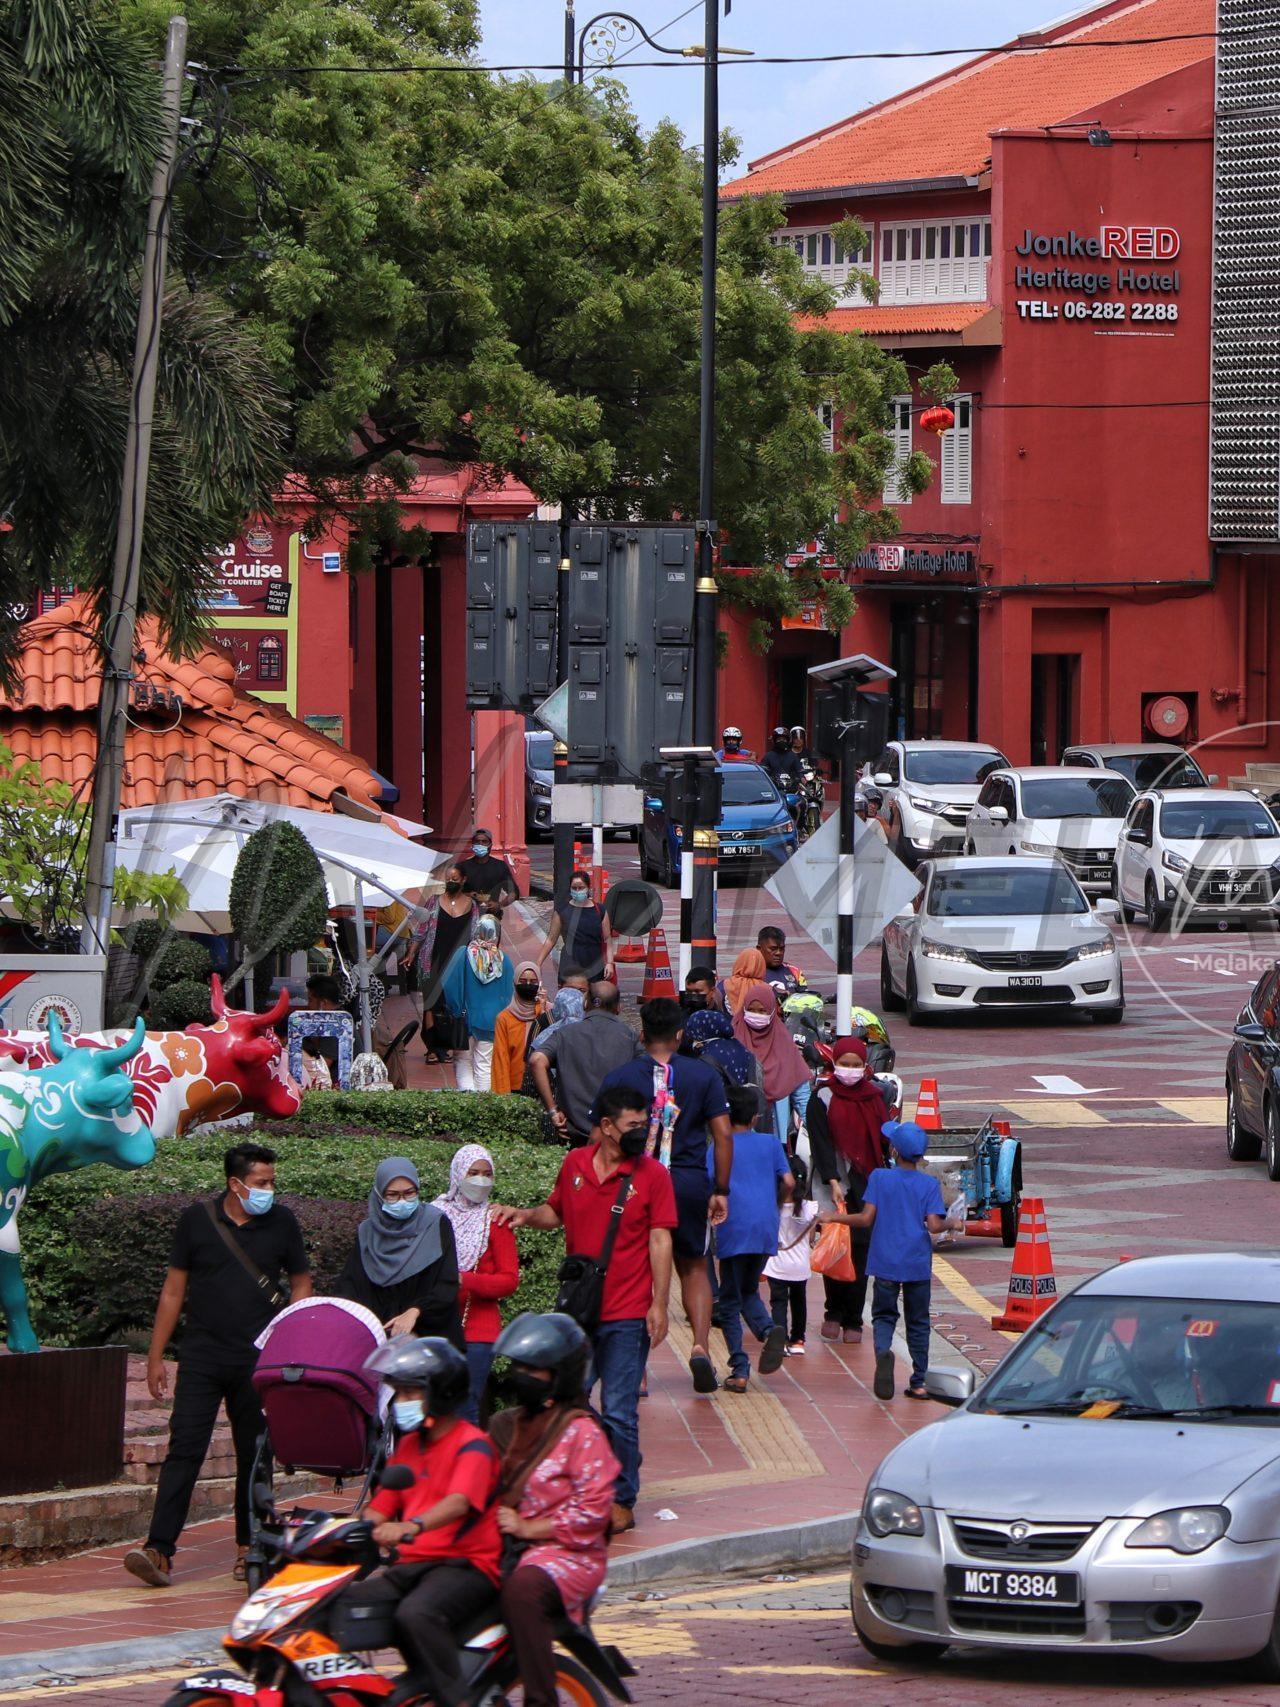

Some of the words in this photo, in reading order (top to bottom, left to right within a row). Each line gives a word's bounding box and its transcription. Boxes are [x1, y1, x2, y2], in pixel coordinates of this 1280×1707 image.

[1016, 266, 1111, 295] Heritage
[1117, 268, 1180, 292] Hotel
[1017, 300, 1059, 318] TEL:
[1064, 301, 1125, 319] 06-282
[1131, 303, 1179, 320] 2288
[220, 559, 282, 578] Cruise
[903, 549, 942, 575] Heritage
[944, 548, 968, 572] Hotel
[267, 604, 281, 612] HERE
[268, 597, 286, 605] TICKET
[1010, 1279, 1032, 1294] POLIS
[1036, 1279, 1055, 1293] POLIS
[964, 1571, 1002, 1595] MCT
[1006, 1574, 1058, 1598] 9384
